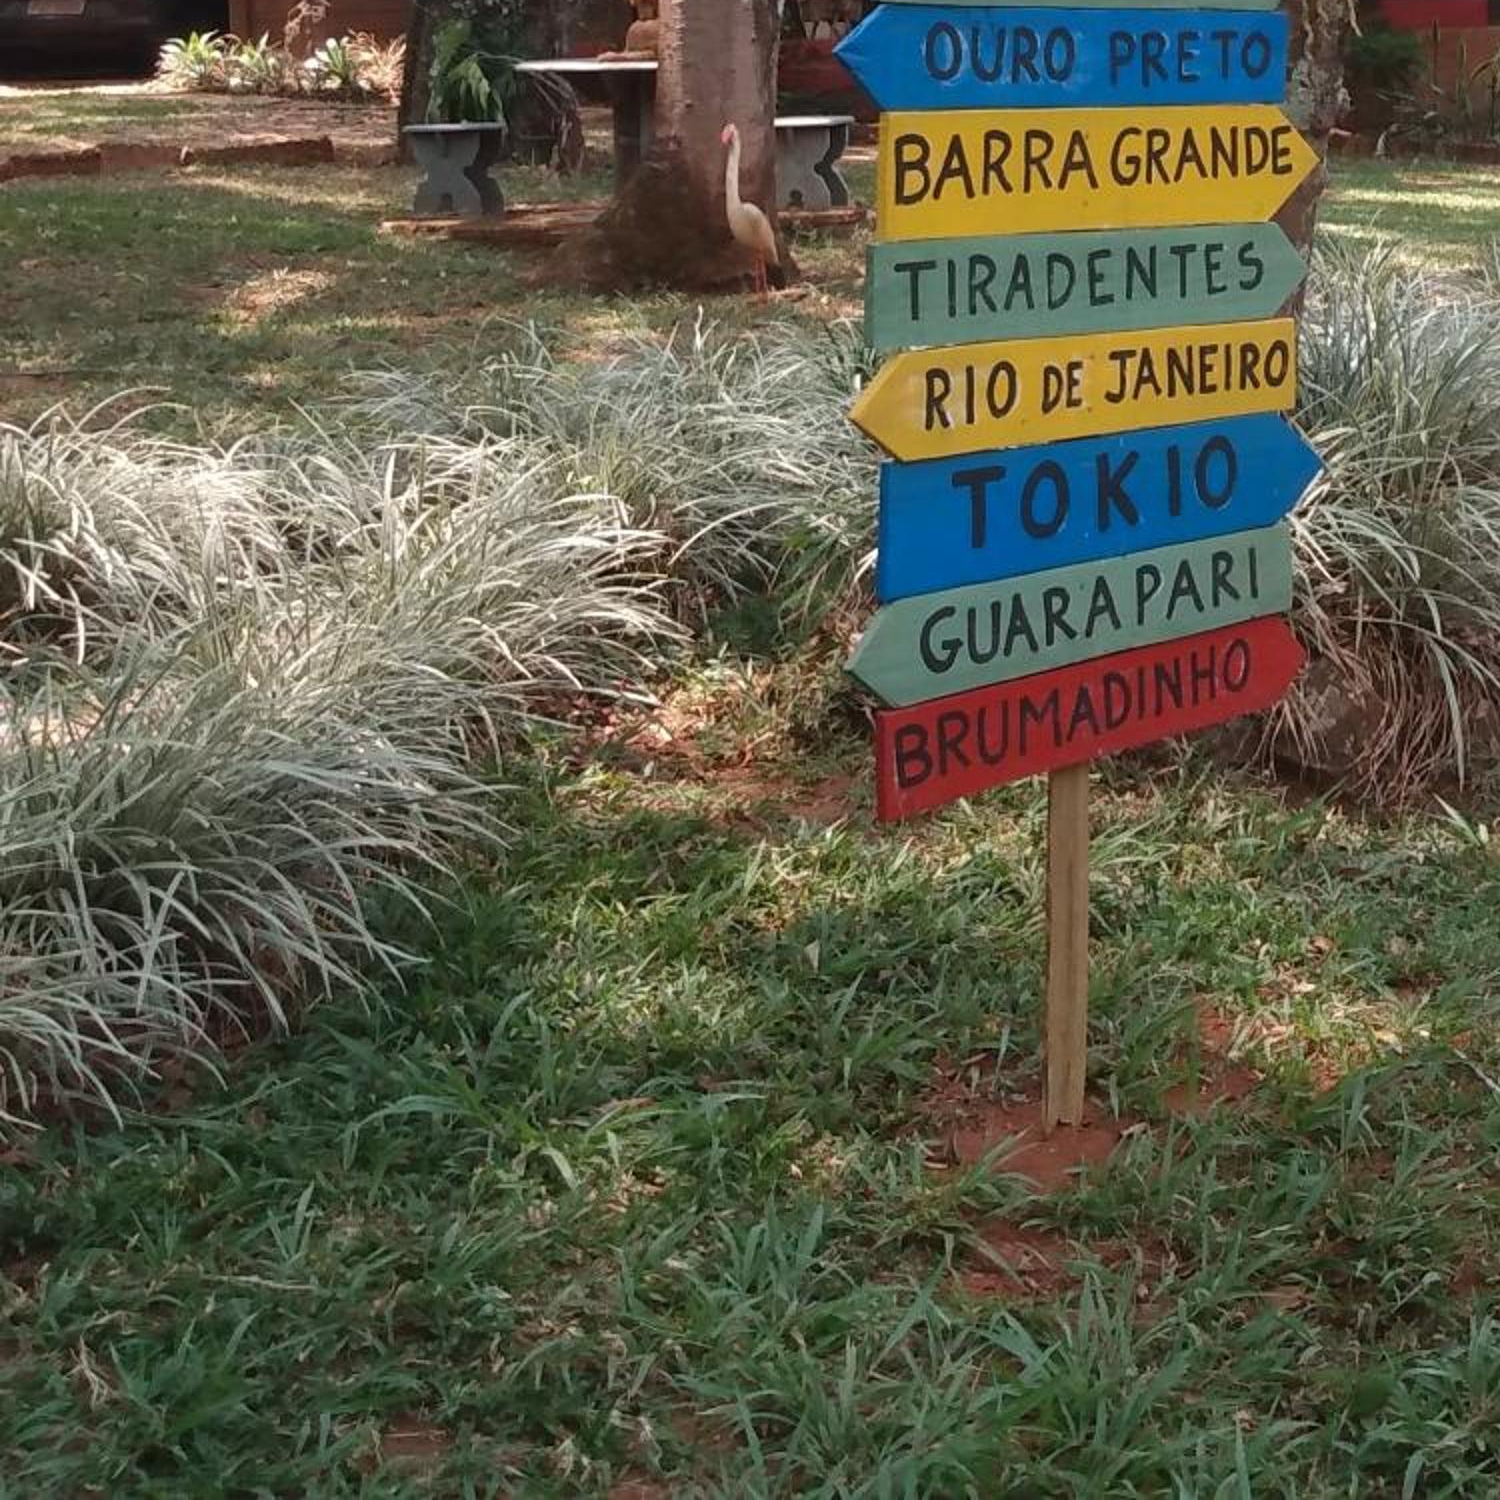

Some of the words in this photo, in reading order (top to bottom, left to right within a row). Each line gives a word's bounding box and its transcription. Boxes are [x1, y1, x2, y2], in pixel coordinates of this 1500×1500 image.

[922, 21, 1077, 83] OURO
[1108, 29, 1272, 88] PRETO
[894, 129, 1099, 205] BARRA
[1110, 125, 1293, 186] GRANDE
[894, 241, 1264, 321] TIRADENTES
[924, 360, 1017, 430] RIO
[1041, 360, 1084, 415] DE
[1104, 339, 1290, 404] JANEIRO
[952, 435, 1238, 549] TOKIO
[919, 547, 1259, 674] GUARAPARI
[895, 638, 1251, 789] BRUMADINHO
